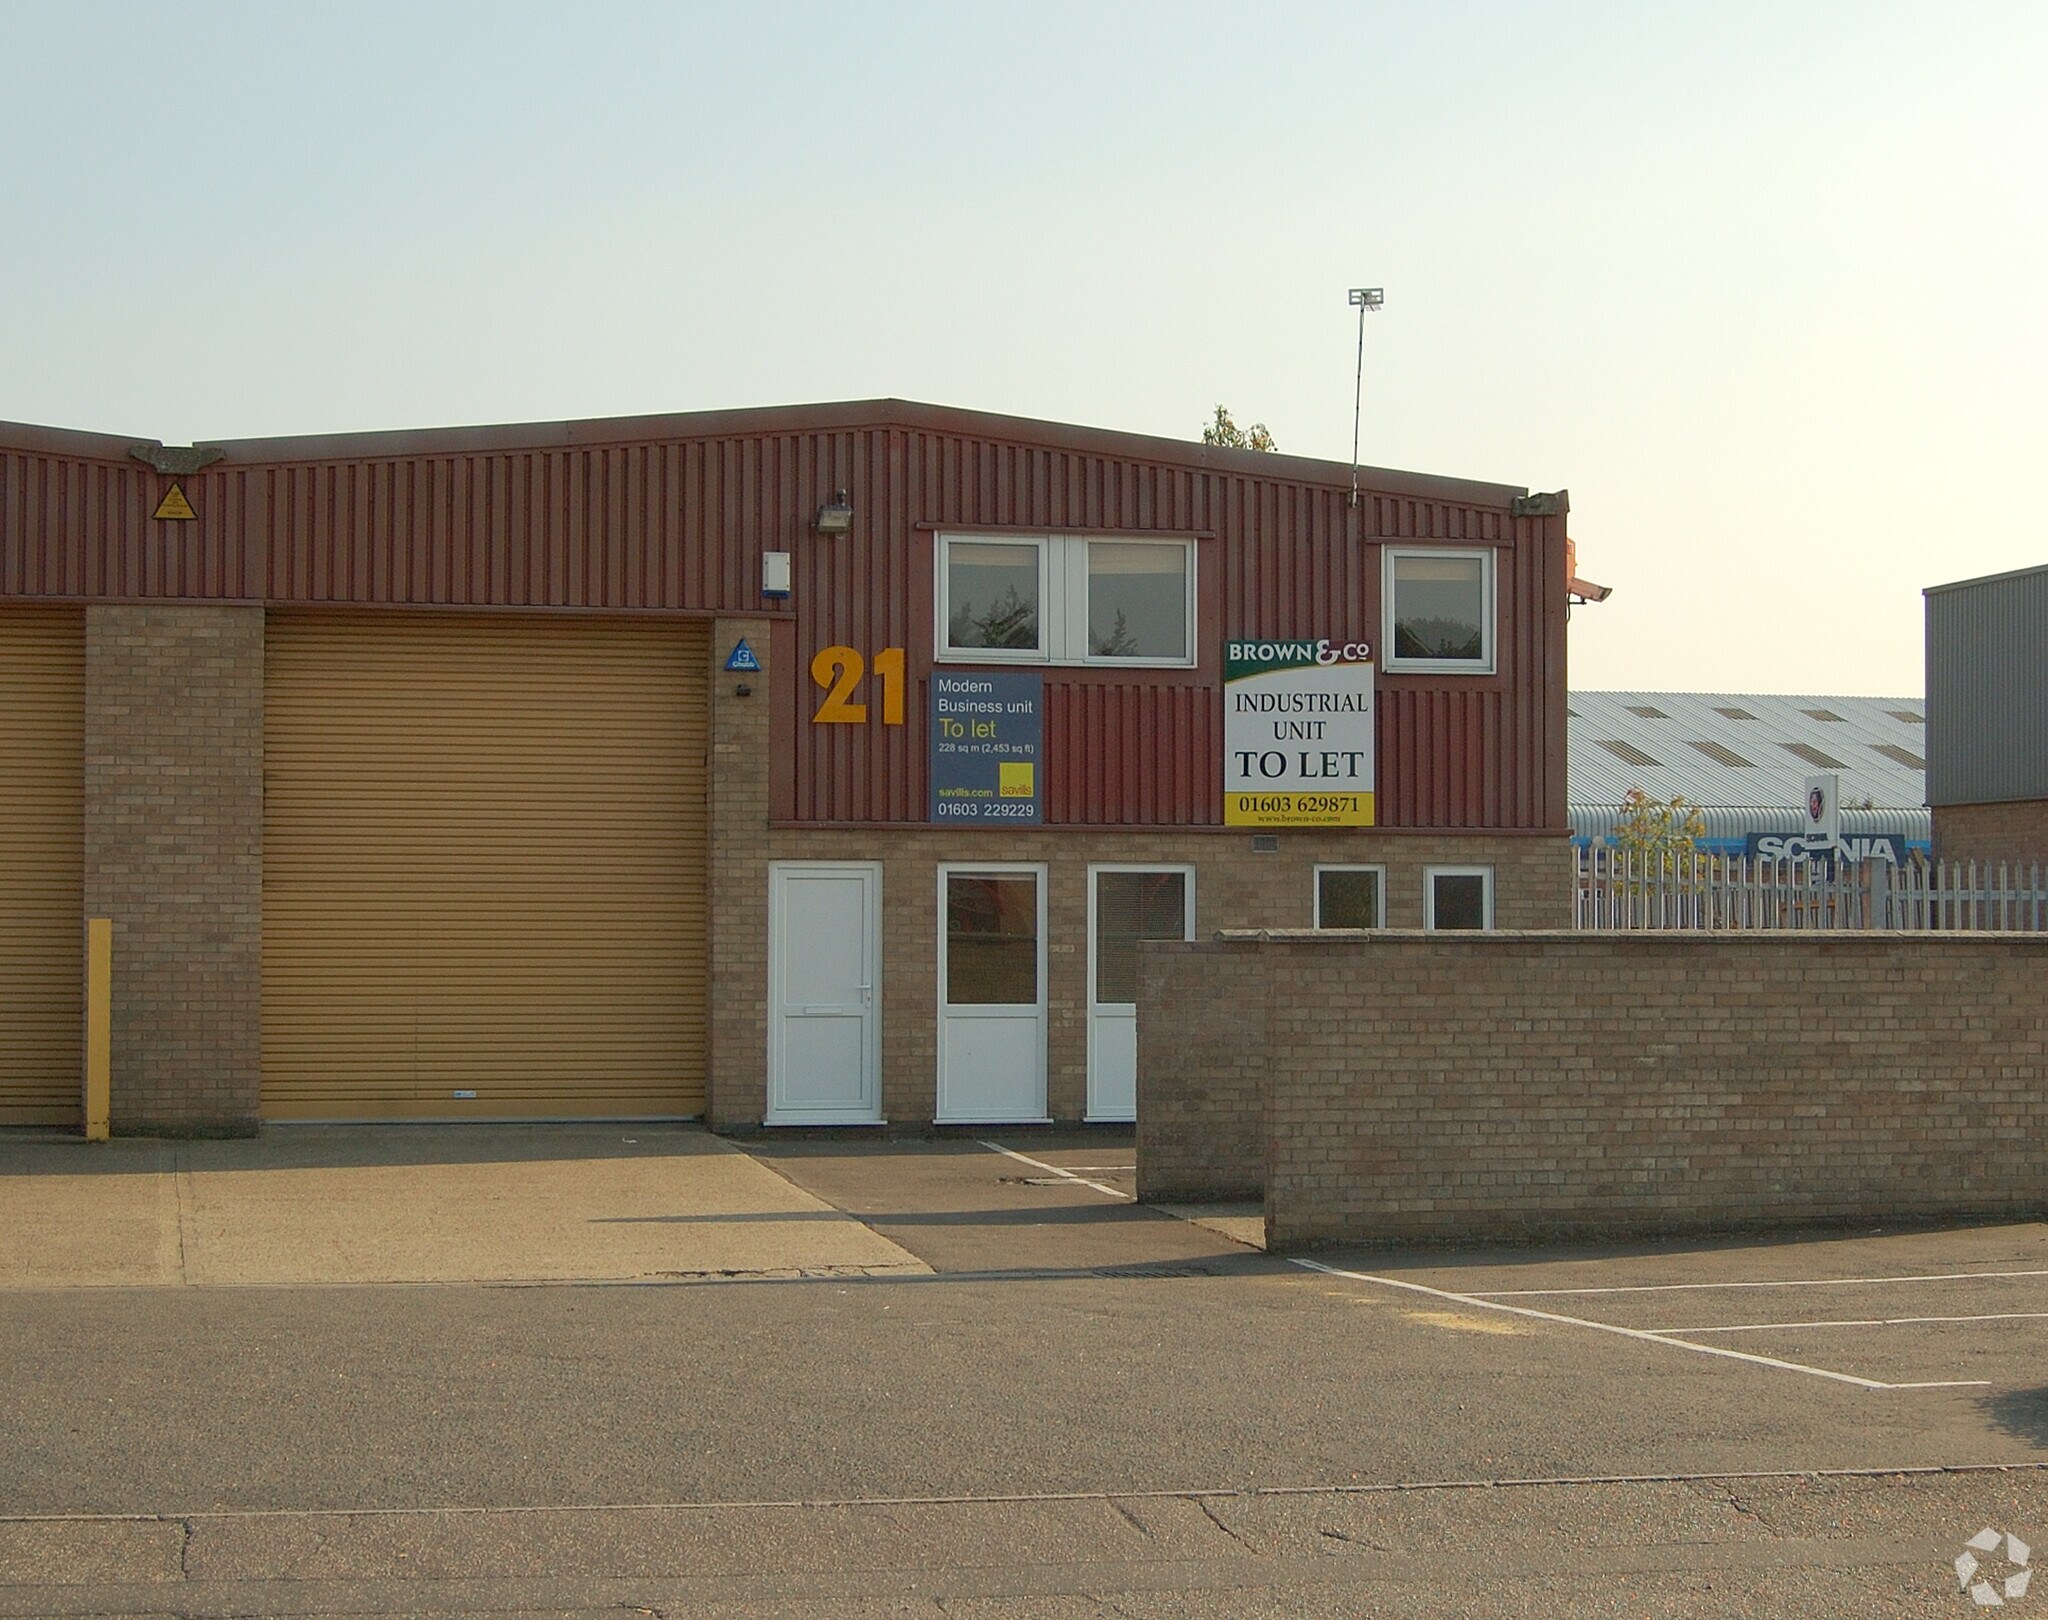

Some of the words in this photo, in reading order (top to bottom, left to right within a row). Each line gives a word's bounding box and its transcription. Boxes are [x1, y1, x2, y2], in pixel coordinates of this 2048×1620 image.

[811, 646, 904, 724] 21
[938, 679, 993, 694] Modern
[938, 699, 1003, 714] Business
[1007, 699, 1034, 714] unit
[1235, 693, 1368, 713] INDUSTRIAL
[938, 717, 964, 738] To
[971, 718, 997, 739] let
[1273, 721, 1328, 740] UNIT
[938, 743, 956, 752] 228
[958, 744, 969, 755] sq
[971, 744, 980, 752] m
[1011, 744, 1023, 755] sq
[1234, 750, 1287, 778] TO
[1298, 751, 1364, 778] LET
[938, 787, 993, 798] savills.com
[938, 802, 978, 816] 01603
[983, 803, 1034, 817] 229229
[1239, 797, 1291, 813] 01603
[1297, 797, 1358, 812] 629871
[1757, 836, 1896, 863] SCNIA
